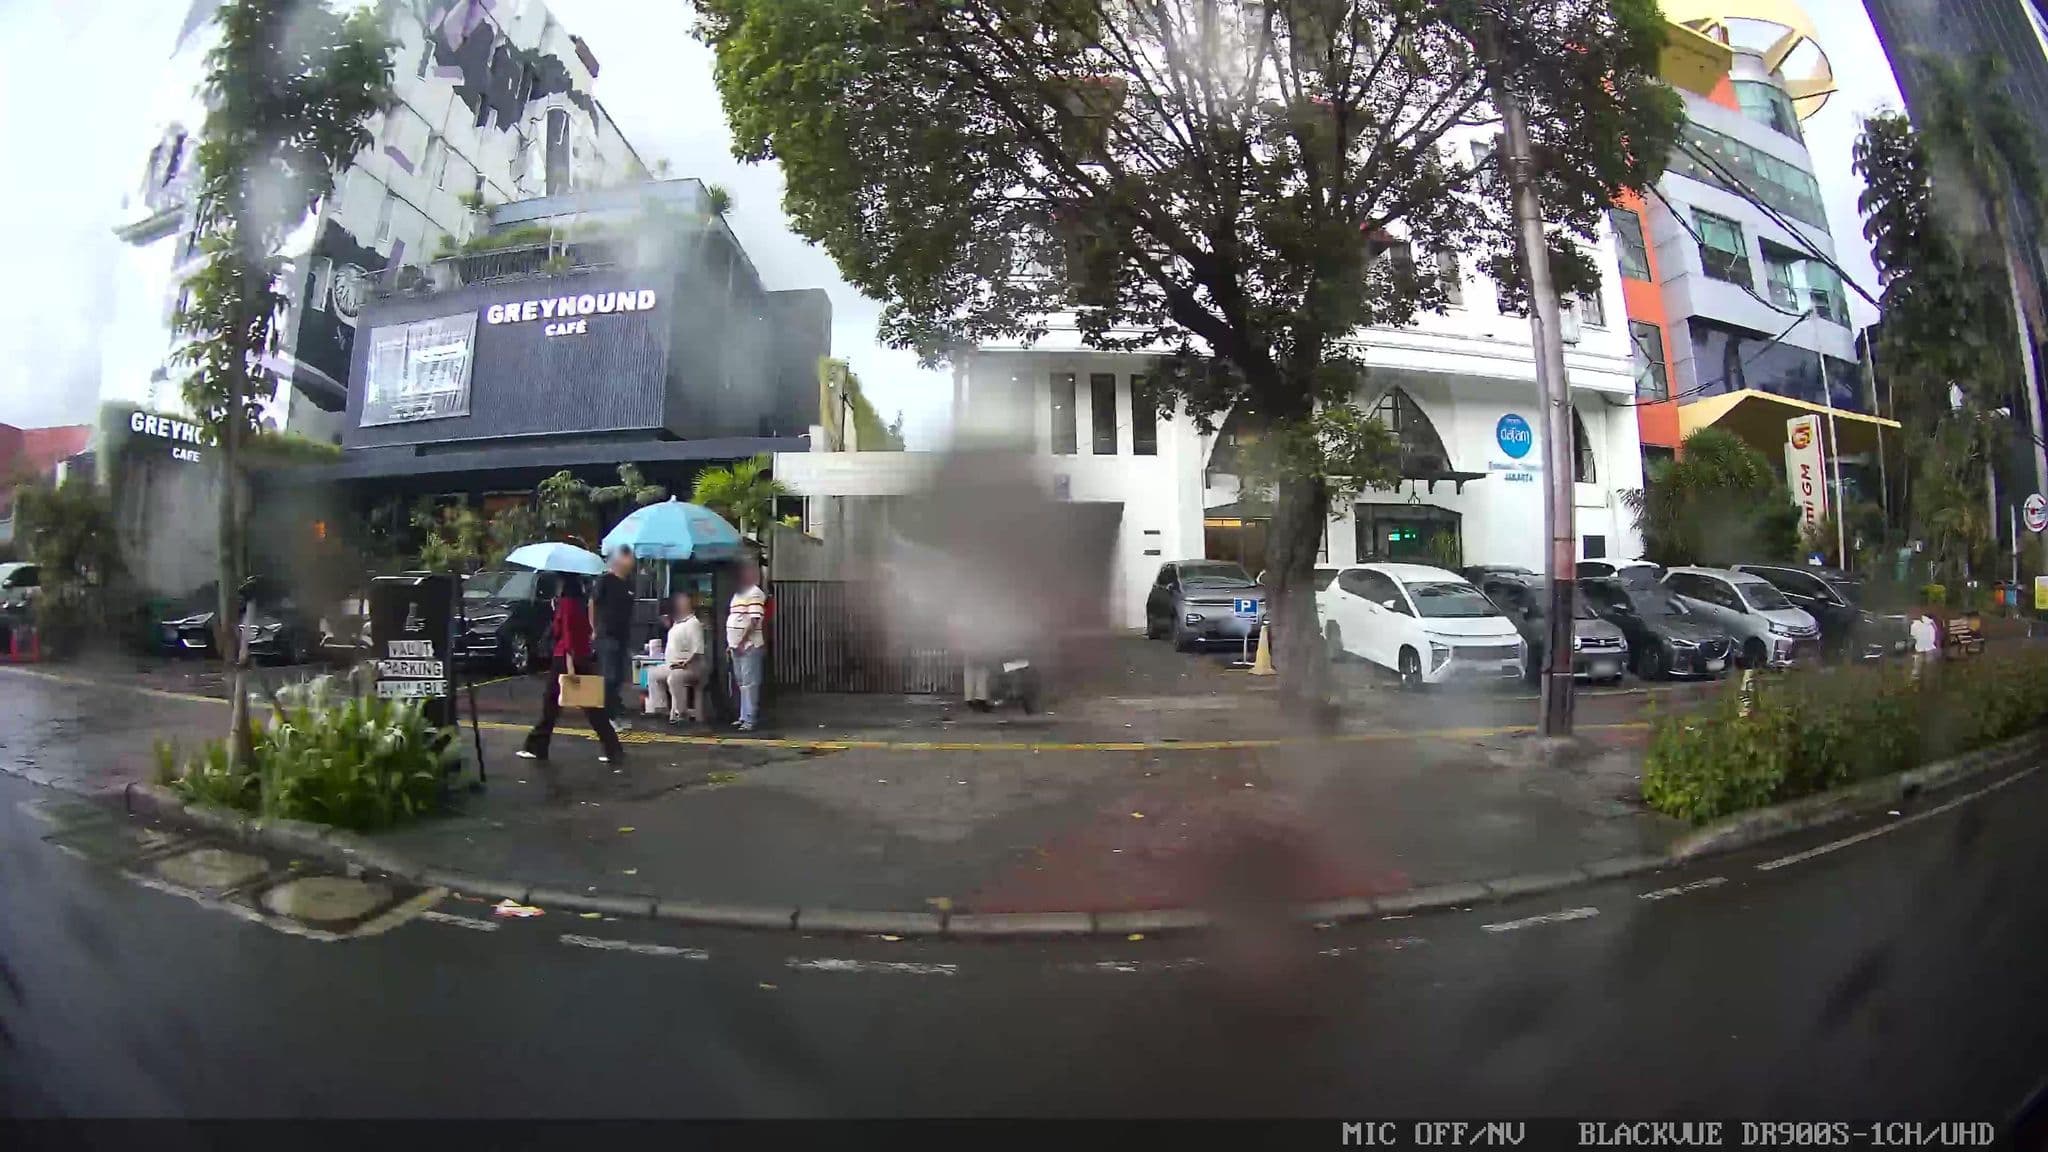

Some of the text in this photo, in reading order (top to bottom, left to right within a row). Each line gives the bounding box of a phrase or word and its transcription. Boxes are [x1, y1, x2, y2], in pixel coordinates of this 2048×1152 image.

[486, 289, 656, 325] GREYHOUND
[1800, 463, 1812, 497] GM
[1241, 600, 1251, 612] P
[383, 661, 443, 677] PARKING
